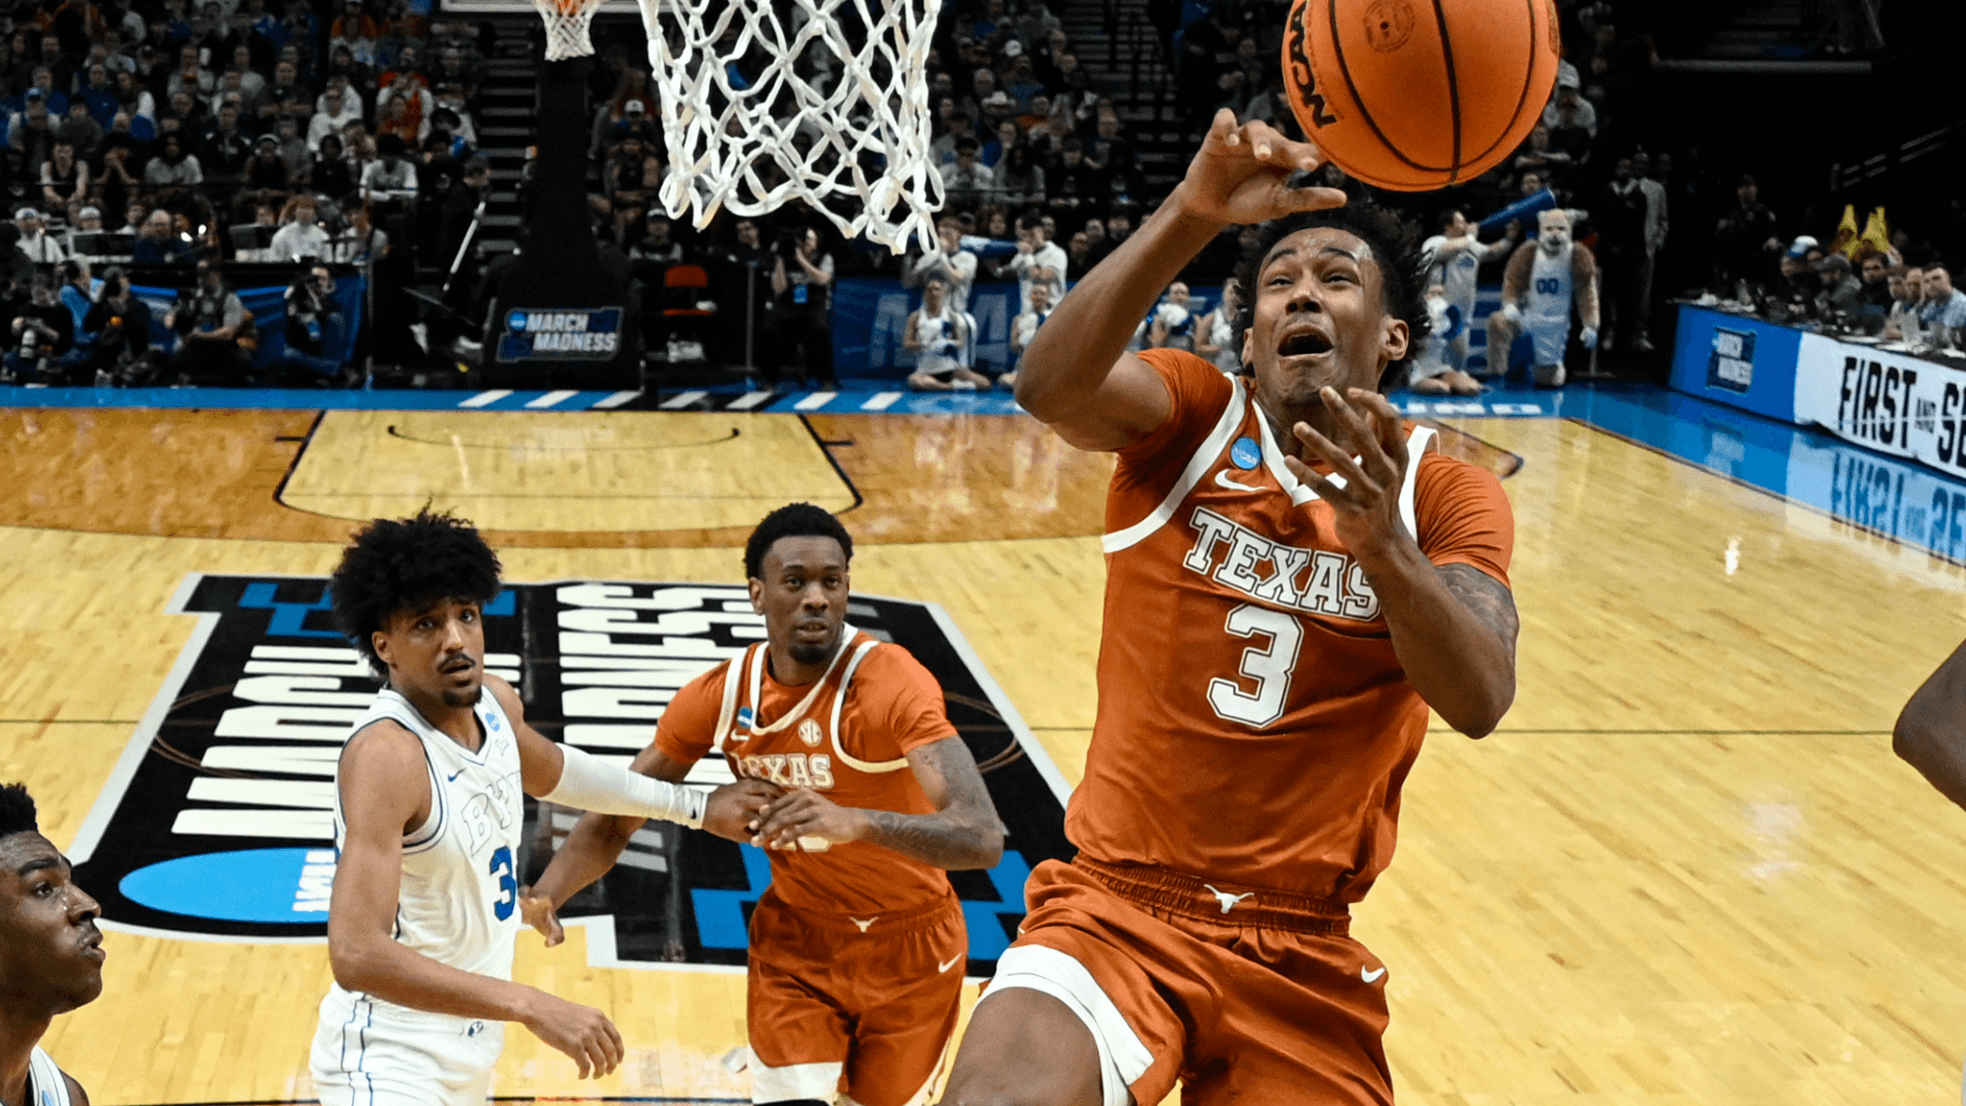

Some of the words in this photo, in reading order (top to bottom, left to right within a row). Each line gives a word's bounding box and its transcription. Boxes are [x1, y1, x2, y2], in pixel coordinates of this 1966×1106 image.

[526, 313, 590, 331] MARCH
[1536, 278, 1559, 295] 00
[533, 332, 617, 351] MADNESS
[1838, 356, 1917, 449] FIRST
[1183, 505, 1381, 622] TEXAS
[1206, 601, 1304, 728] 3
[489, 845, 517, 922] 3
